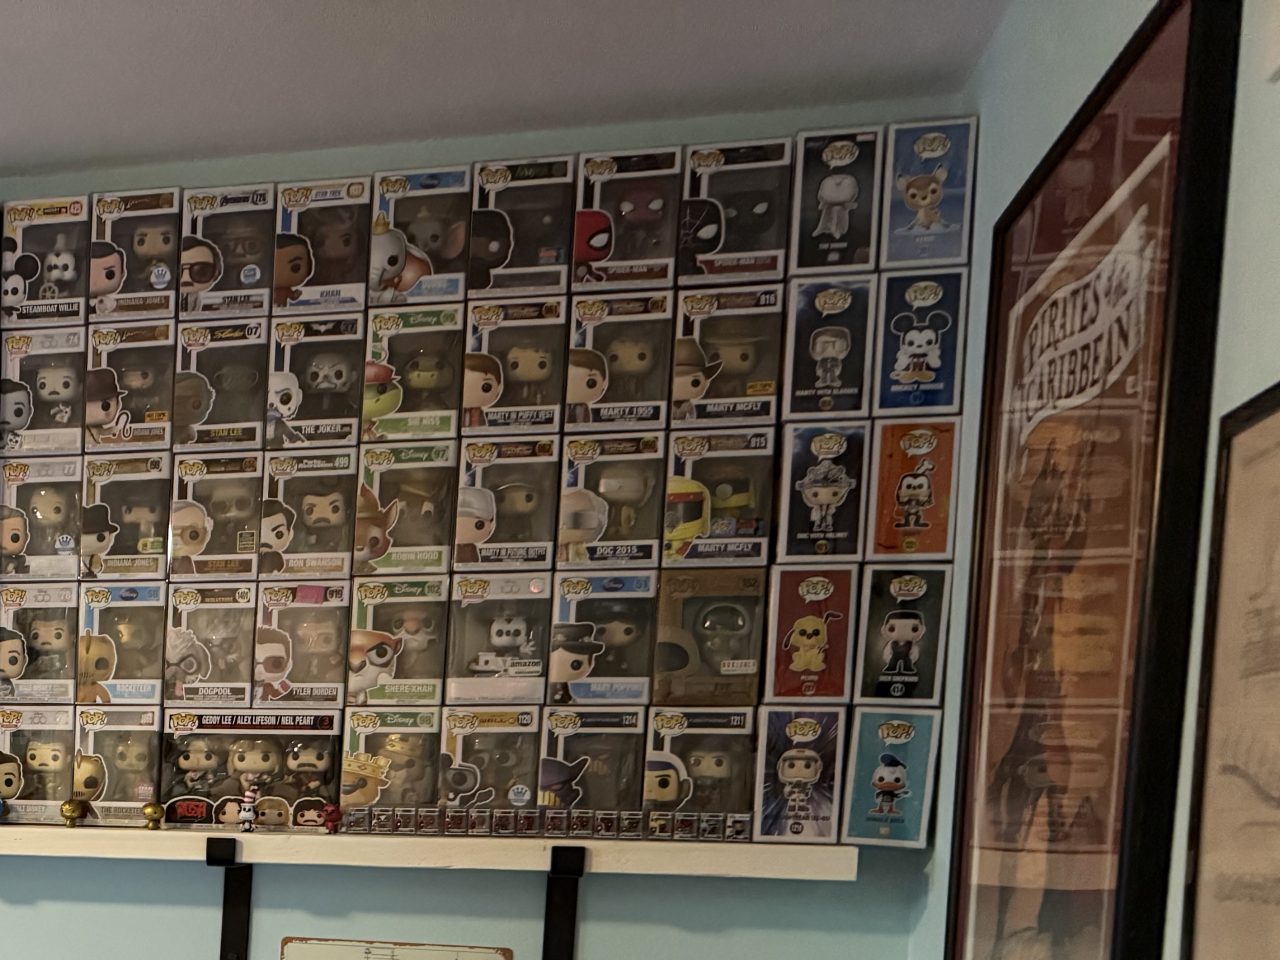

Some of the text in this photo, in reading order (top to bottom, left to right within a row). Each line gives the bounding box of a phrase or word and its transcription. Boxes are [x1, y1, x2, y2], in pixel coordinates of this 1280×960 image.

[760, 293, 775, 305] 816
[22, 302, 79, 313] STEAMBOAT WILLIE
[1026, 272, 1100, 376] PIRATES
[246, 326, 260, 336] 07
[184, 328, 210, 348] POP!
[1024, 301, 1136, 423] CARIBBEAN
[600, 406, 654, 416] MARTY 1955
[706, 402, 761, 413] MARTY MCFLY
[301, 424, 342, 434] THE JOKER
[751, 436, 766, 448] 815
[335, 456, 351, 468] 499
[596, 546, 638, 556] DOC 2015
[698, 543, 752, 554] MARTY MCFLY
[416, 550, 439, 560] HOOD
[288, 558, 342, 568] RON SWANSON
[510, 660, 541, 668] amazon
[198, 688, 232, 696] DOGPOOL
[293, 687, 336, 696] TYLER DURDEN
[384, 684, 433, 694] SHERE KHAN
[202, 715, 220, 724] GEDDY
[221, 716, 231, 724] LEE
[236, 716, 250, 725] ALEX
[251, 716, 276, 726] LIFESON
[282, 717, 294, 726] NEIL
[296, 717, 314, 726] PEART
[622, 715, 638, 725] 1214
[788, 722, 819, 740] POP!
[882, 723, 916, 741] POP!
[175, 802, 206, 818] RUSH
